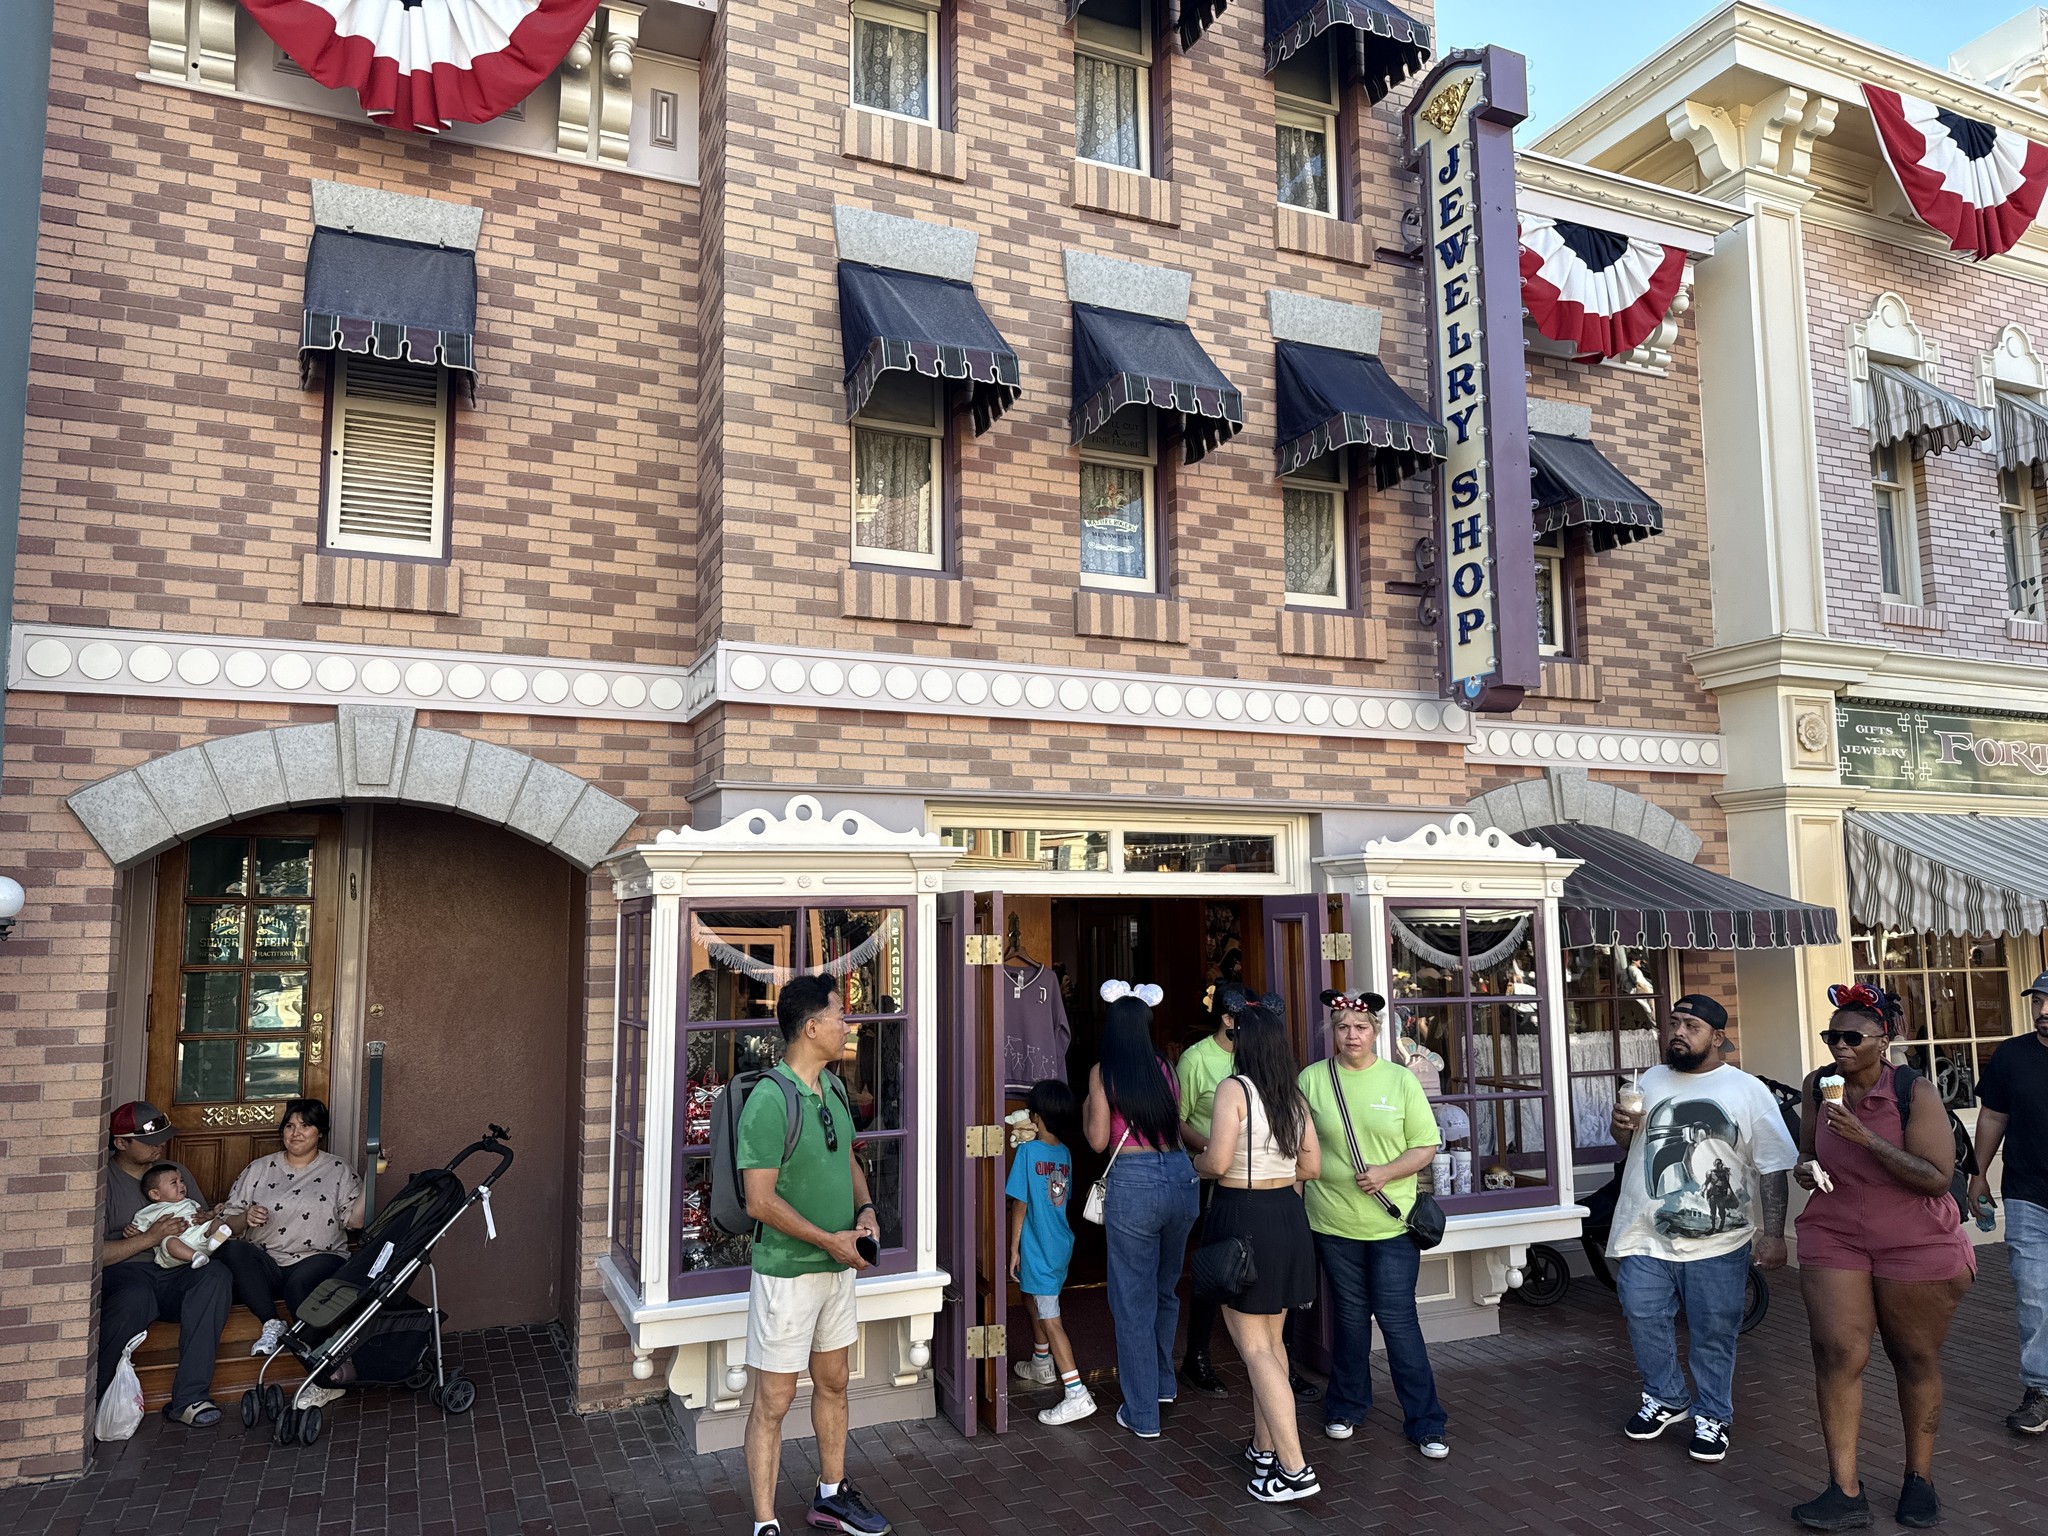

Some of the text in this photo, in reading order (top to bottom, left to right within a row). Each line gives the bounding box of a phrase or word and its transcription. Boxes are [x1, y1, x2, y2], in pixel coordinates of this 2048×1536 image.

[1433, 143, 1485, 646] JEWELRY SHOP
[1112, 429, 1120, 438] A
[1091, 531, 1133, 540] MENSWEAR
[1855, 724, 1894, 736] GIFTS
[1842, 744, 1908, 759] JEWELRY
